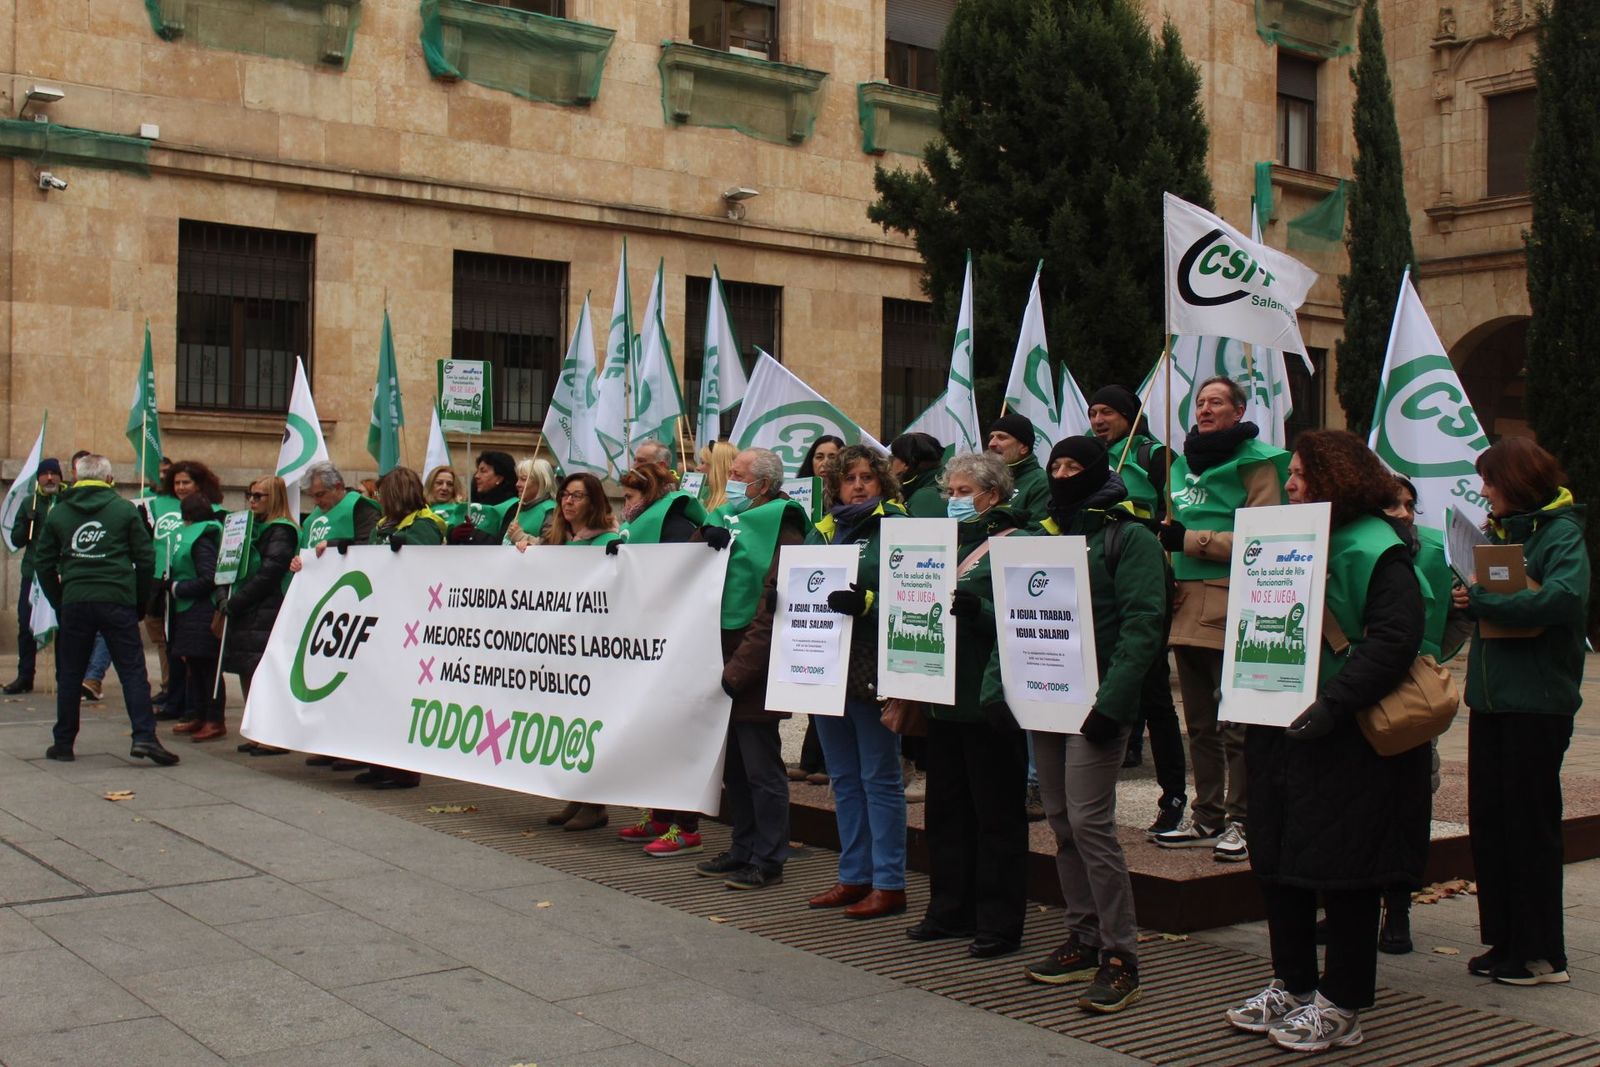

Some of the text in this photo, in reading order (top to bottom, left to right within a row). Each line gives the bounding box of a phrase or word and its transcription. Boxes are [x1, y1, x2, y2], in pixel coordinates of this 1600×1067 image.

[470, 512, 486, 529] SIF
[78, 530, 107, 543] CSIF
[892, 571, 903, 579] Con
[910, 572, 924, 580] salud
[925, 572, 932, 580] de
[1246, 568, 1260, 577] Con
[1261, 568, 1267, 577] la
[1268, 567, 1284, 577] salud
[1285, 567, 1293, 576] de
[510, 589, 572, 613] SALARIAL
[576, 591, 609, 614] YA!!!
[896, 590, 936, 603] NO SE JUEGA
[1250, 589, 1297, 603] NO SE JUEGA
[788, 603, 794, 612] A
[794, 603, 811, 613] IGUAL
[1010, 608, 1074, 622] A IGUAL TRABAJO,
[791, 619, 834, 630] IGUAL SALARIO
[310, 611, 379, 660] CSIF
[1016, 627, 1070, 640] IGUAL SALARIO
[422, 624, 481, 649] MEJORES
[484, 629, 577, 657] CONDICIONES
[581, 635, 667, 661] LABORALES
[440, 656, 471, 684] MÁS
[473, 665, 527, 690] EMPLEO
[529, 665, 591, 697] PÚBLICO
